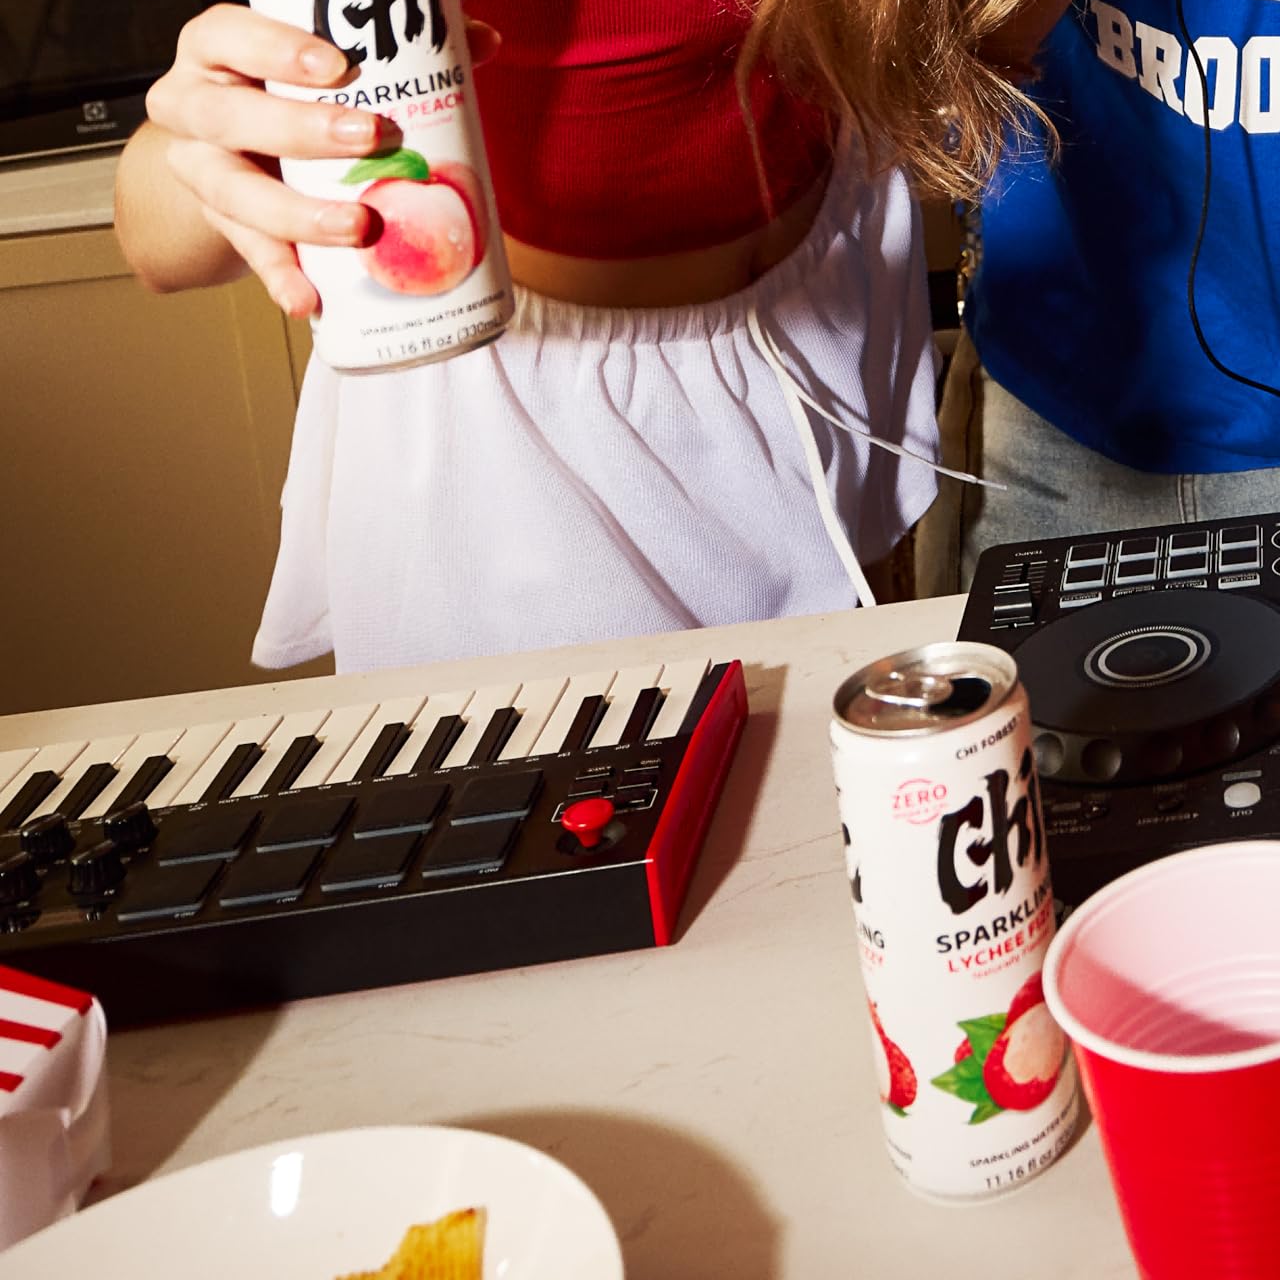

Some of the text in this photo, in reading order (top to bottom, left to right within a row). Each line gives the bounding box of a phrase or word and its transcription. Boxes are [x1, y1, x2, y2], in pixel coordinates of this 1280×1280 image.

[955, 716, 1017, 760] CHI FOREST
[891, 783, 948, 810] ZERO
[1230, 809, 1253, 818] OUT
[948, 931, 1025, 973] LYCHEE
